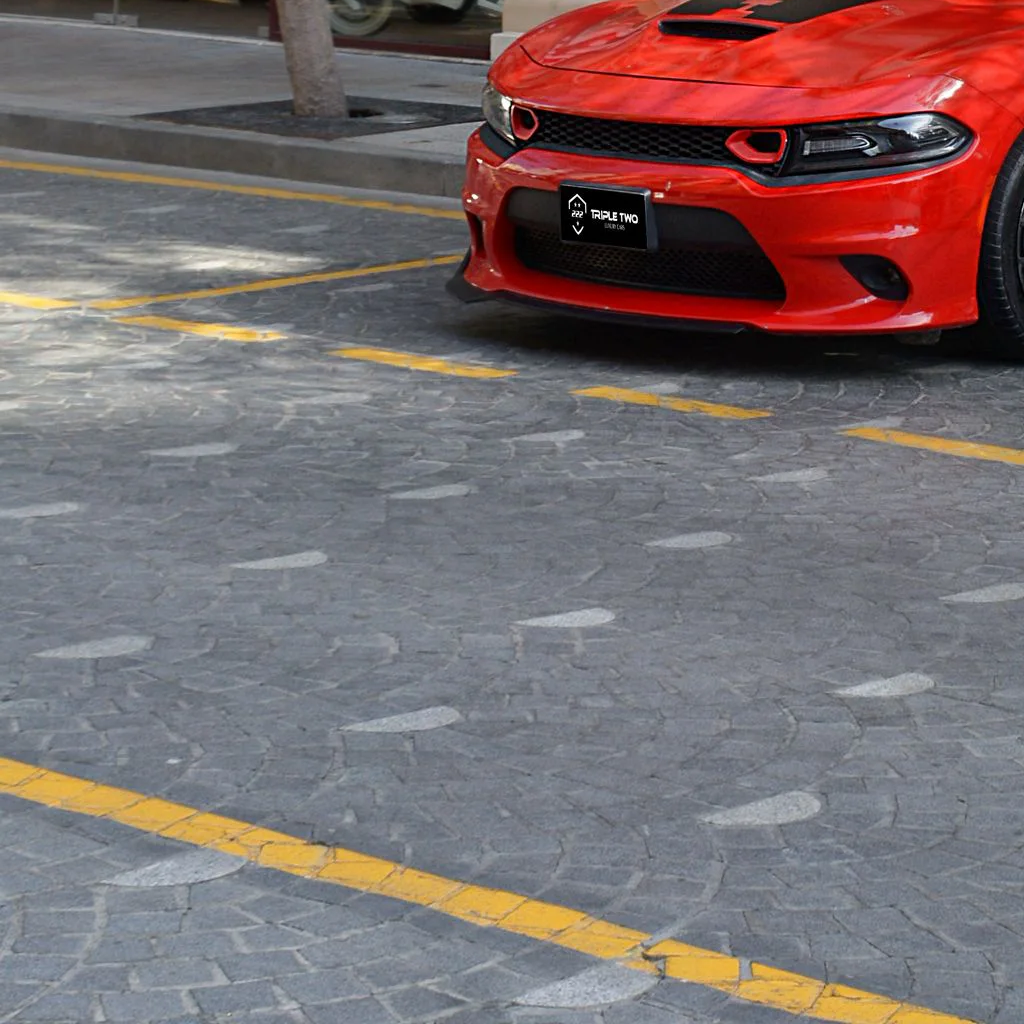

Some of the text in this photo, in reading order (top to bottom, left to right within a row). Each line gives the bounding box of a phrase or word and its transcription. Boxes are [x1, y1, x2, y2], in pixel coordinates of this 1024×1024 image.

[571, 209, 584, 219] 222
[590, 208, 639, 224] TRIPLE TWO
